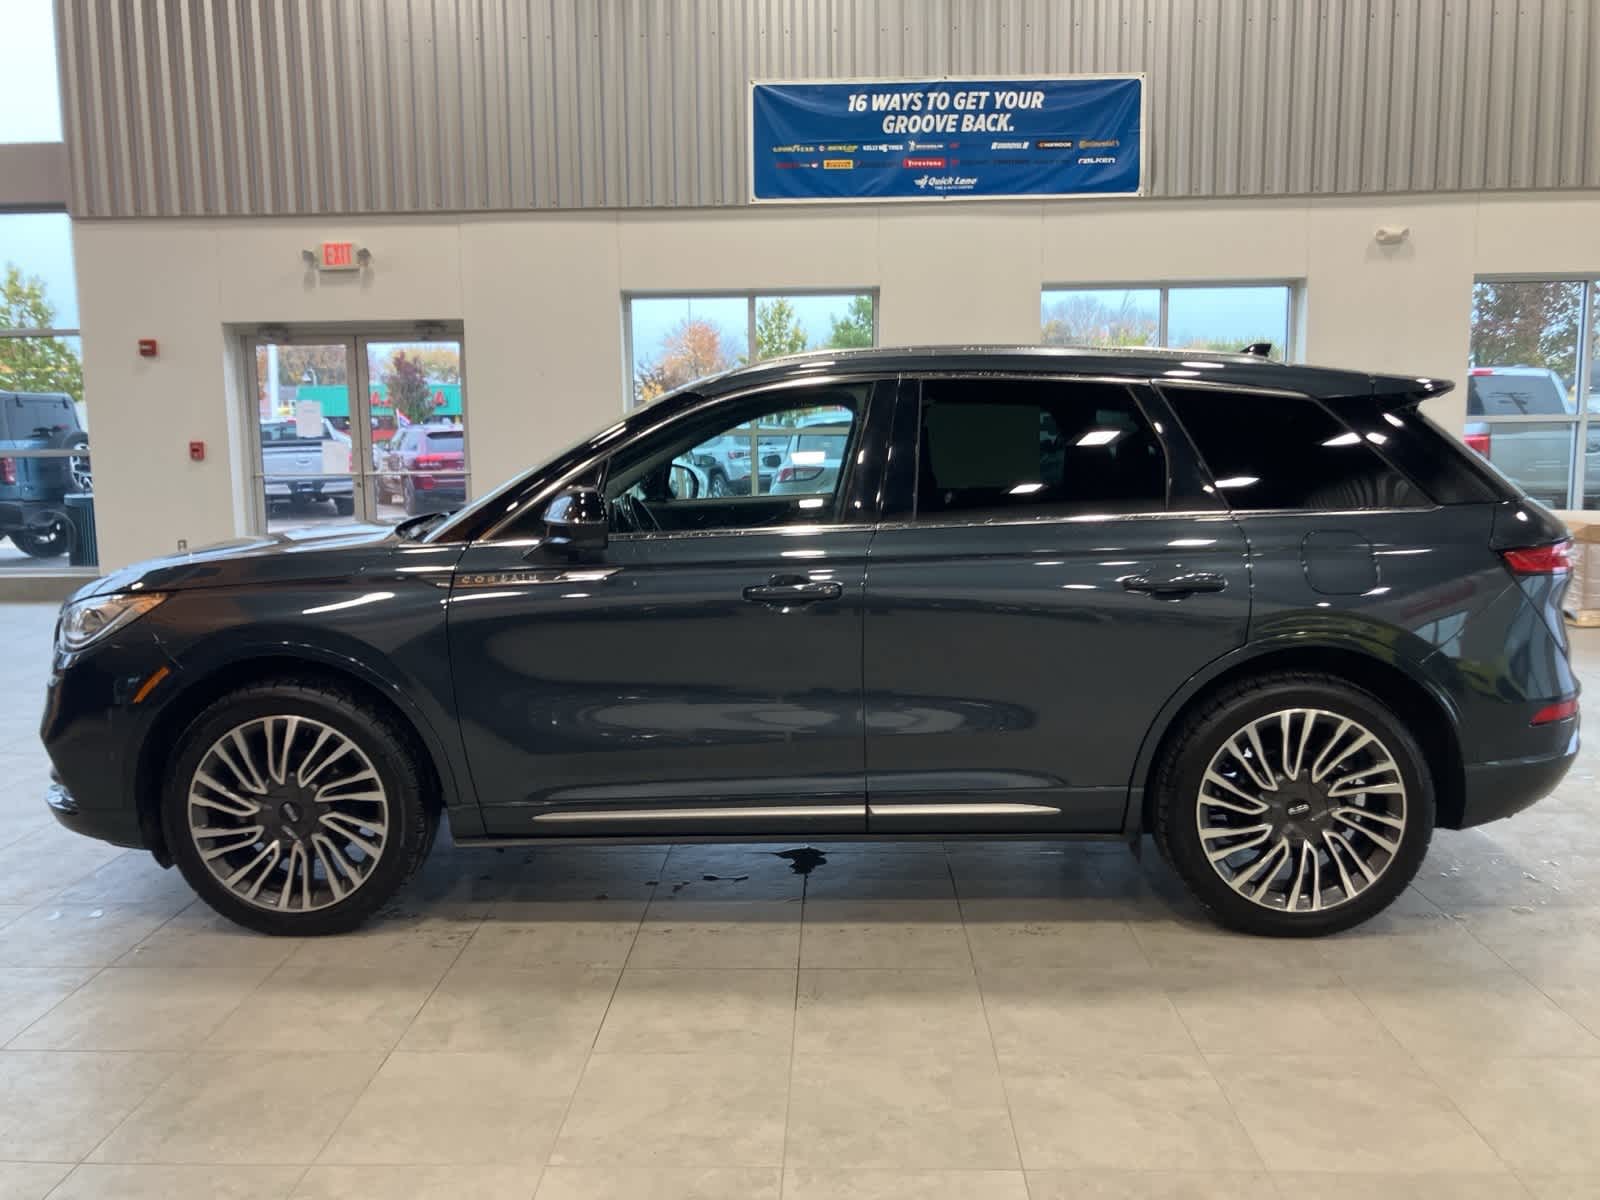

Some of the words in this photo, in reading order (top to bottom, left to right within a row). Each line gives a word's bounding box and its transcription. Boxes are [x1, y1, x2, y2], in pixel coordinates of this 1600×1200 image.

[848, 94, 868, 112] 16
[871, 92, 924, 112] WAYS
[927, 92, 950, 111] TO
[953, 91, 990, 111] GET
[994, 91, 1045, 110] YOUR
[882, 114, 959, 134] GROOVE
[961, 113, 1015, 132] BACK.
[928, 176, 954, 186] Quick
[954, 176, 978, 185] Lane
[322, 241, 353, 266] EXIT
